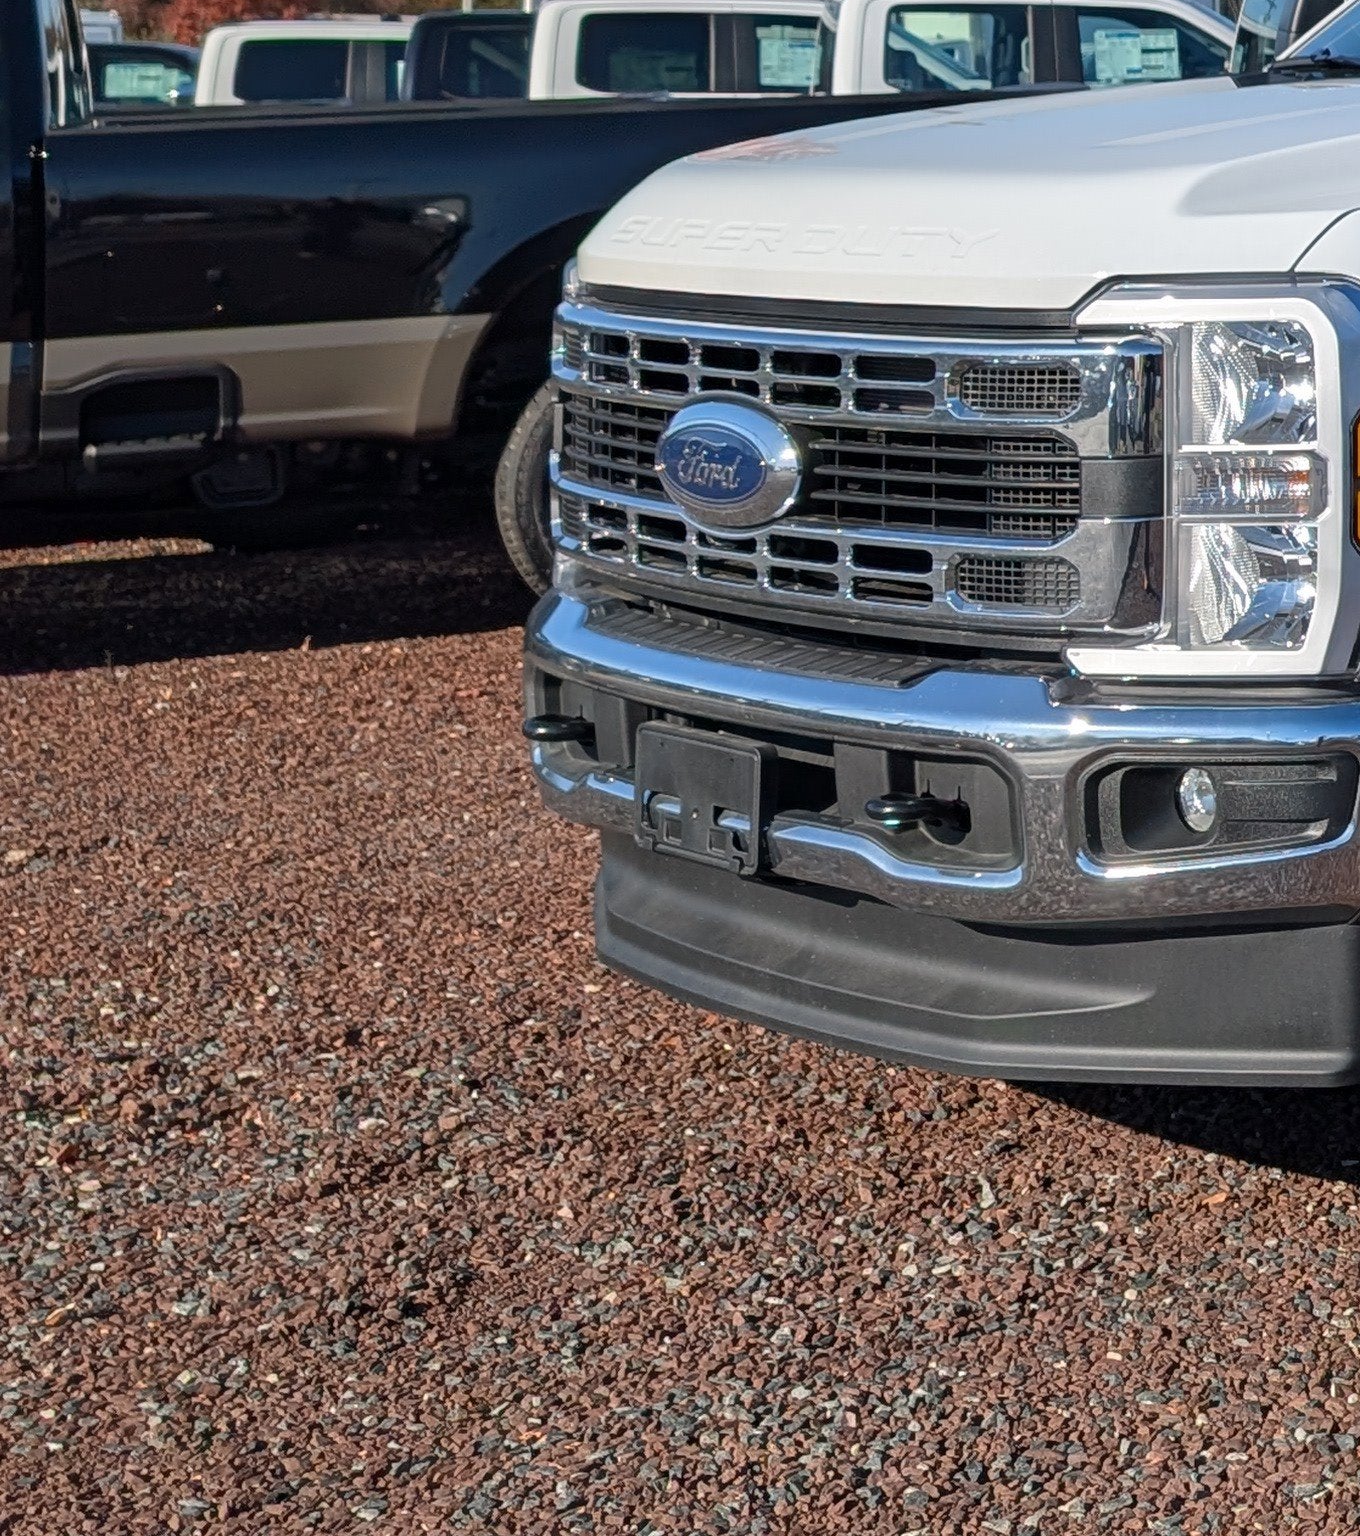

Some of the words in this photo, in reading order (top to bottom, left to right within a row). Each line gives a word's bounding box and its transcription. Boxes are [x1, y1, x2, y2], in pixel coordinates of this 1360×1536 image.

[609, 216, 790, 253] SUPER
[793, 224, 1001, 259] DUTY
[678, 437, 742, 490] Ford
